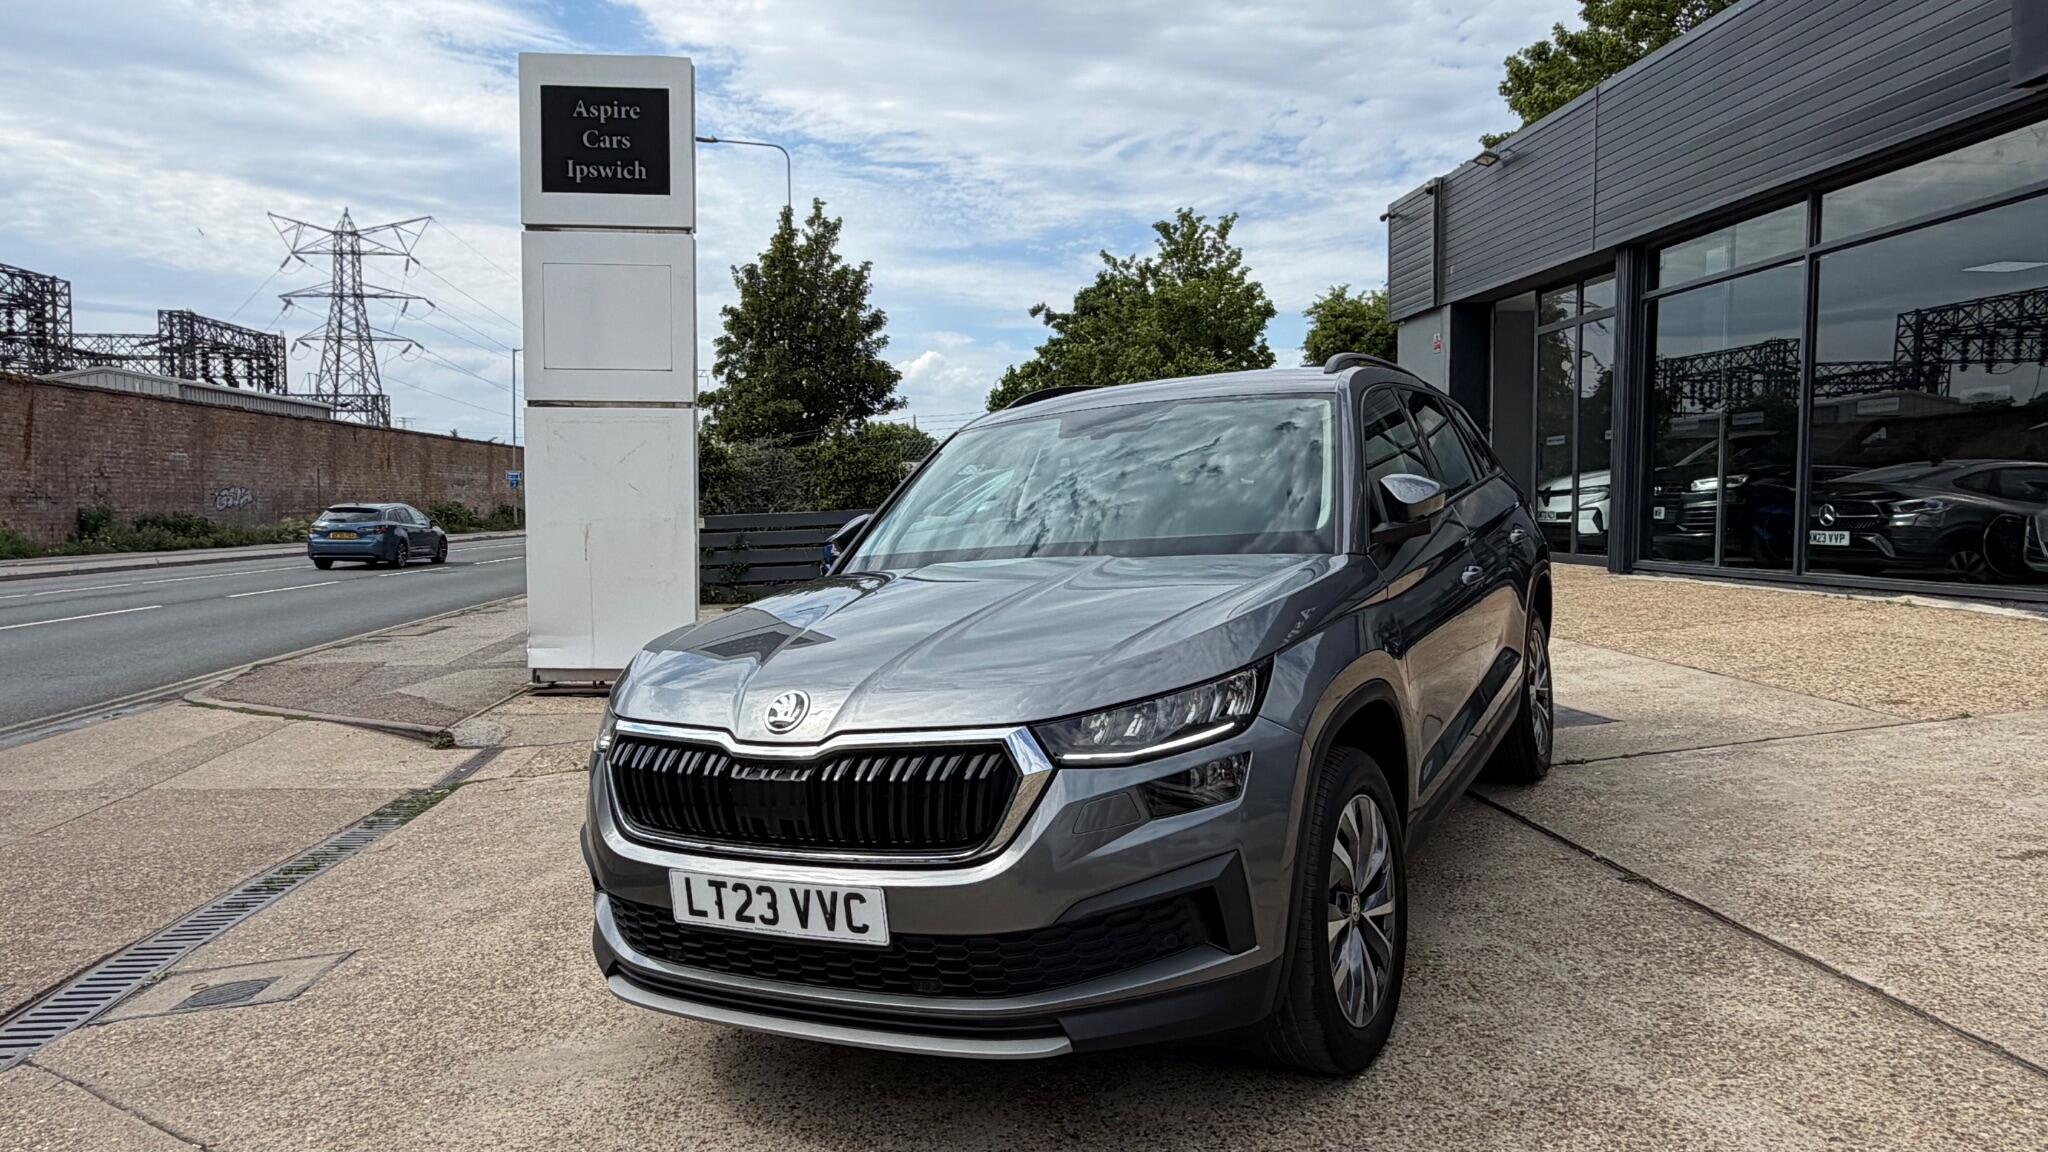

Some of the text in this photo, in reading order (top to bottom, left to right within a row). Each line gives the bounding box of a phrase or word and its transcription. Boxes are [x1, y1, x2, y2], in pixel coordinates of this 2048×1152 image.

[572, 99, 641, 124] Aspire
[582, 129, 632, 149] Cars
[567, 159, 647, 183] Ipswich
[1828, 533, 1846, 543] VVP
[684, 877, 870, 934] LT23 VVC
